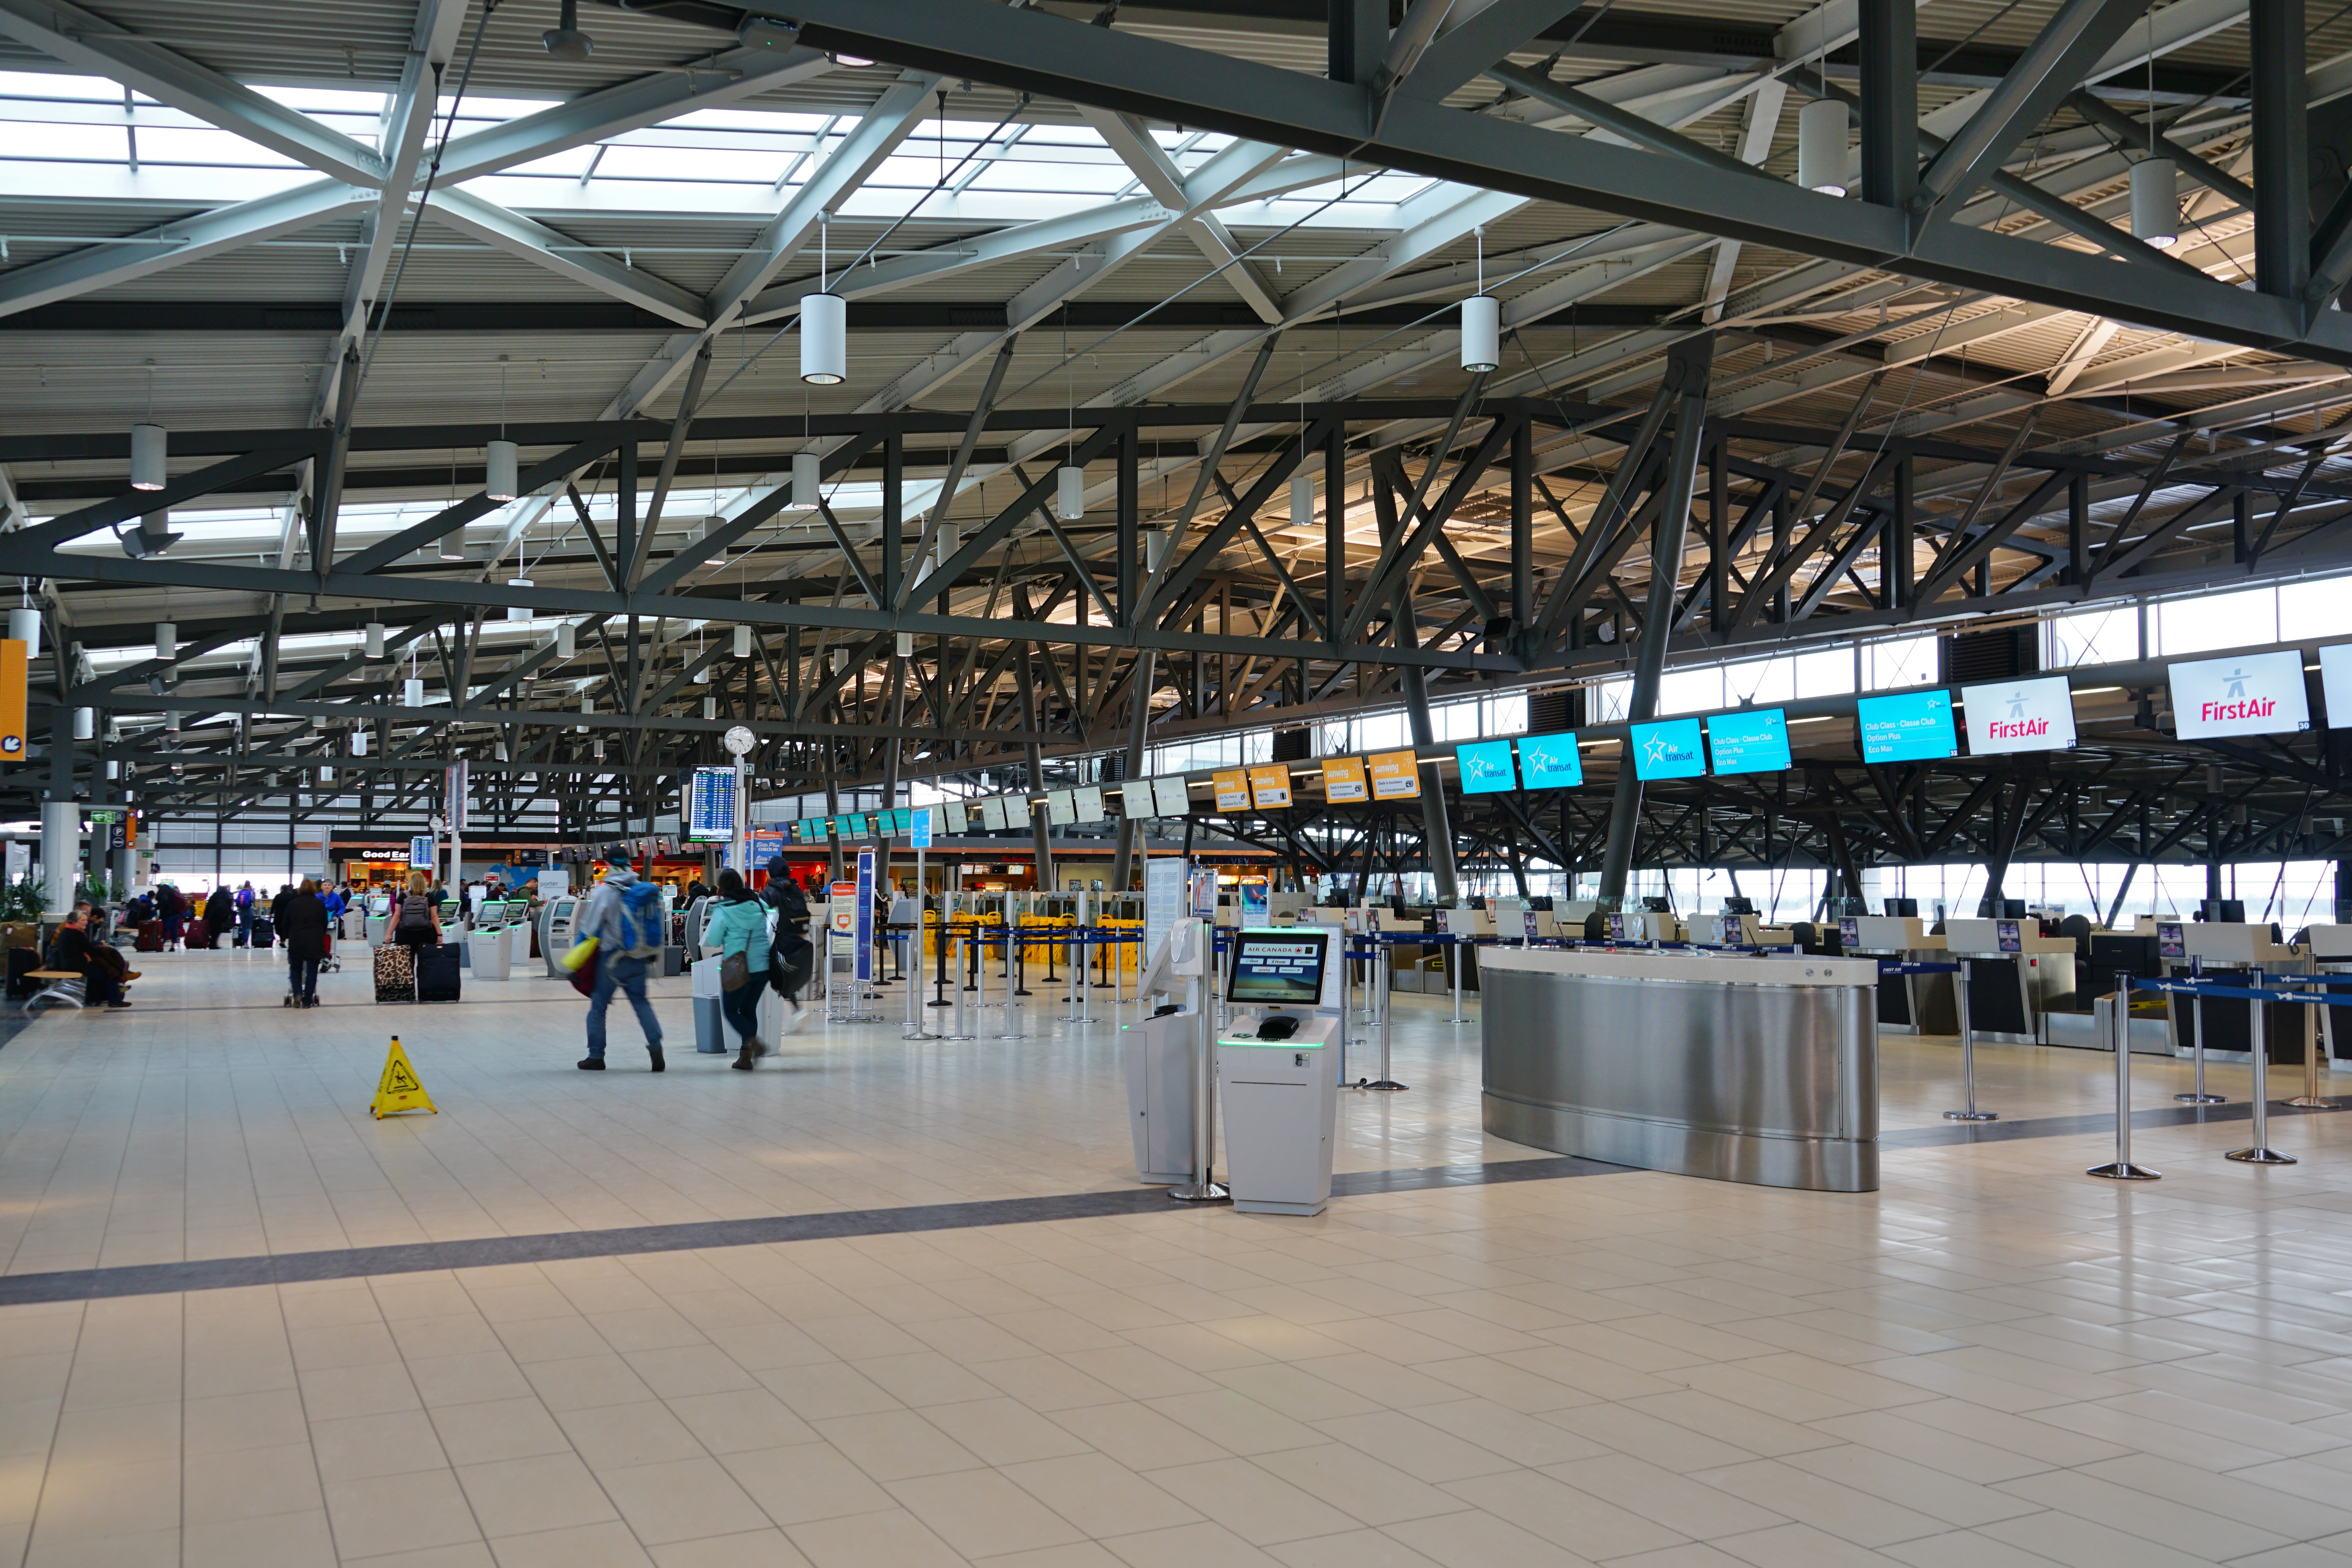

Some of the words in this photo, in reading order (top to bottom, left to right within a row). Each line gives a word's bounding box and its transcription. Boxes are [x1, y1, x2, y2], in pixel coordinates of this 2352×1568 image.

[2202, 696, 2276, 722] FirstAir
[1990, 717, 2049, 739] FirstAir
[1866, 733, 1887, 743] Option
[1668, 744, 1678, 753] Air
[1715, 748, 1732, 757] Option
[1550, 756, 1558, 764] Air
[1665, 750, 1694, 762] transat
[1374, 764, 1399, 773] sunwing
[1548, 762, 1572, 772] transat
[1327, 769, 1348, 778] sunwing
[1485, 768, 1506, 778] transat
[1217, 781, 1234, 789] sunwing
[1255, 777, 1275, 786] sunwing
